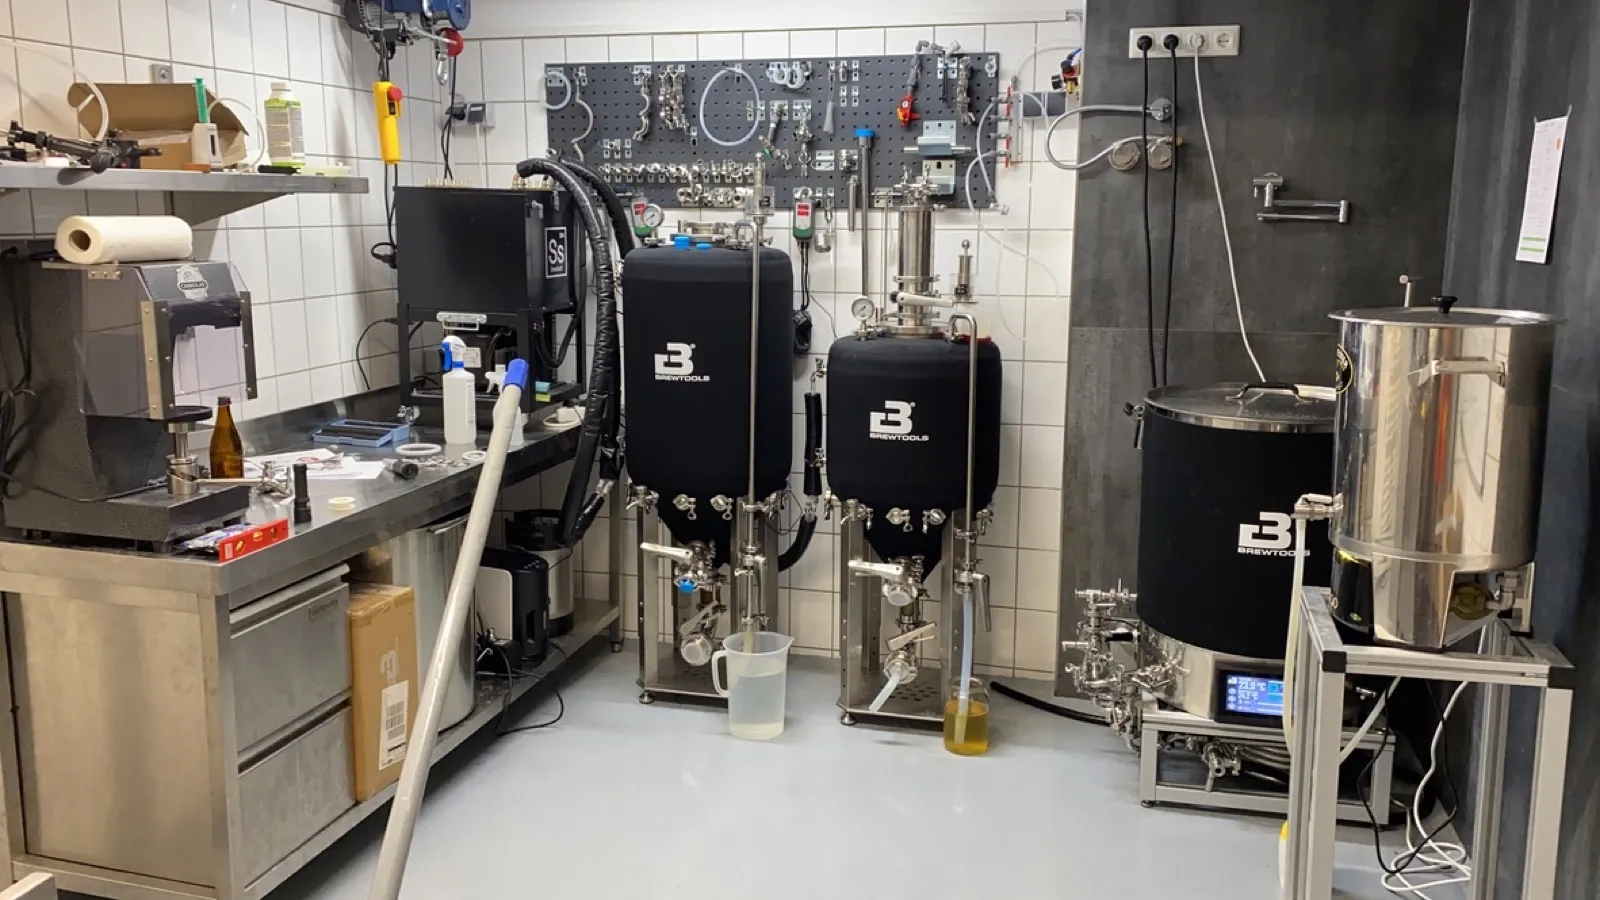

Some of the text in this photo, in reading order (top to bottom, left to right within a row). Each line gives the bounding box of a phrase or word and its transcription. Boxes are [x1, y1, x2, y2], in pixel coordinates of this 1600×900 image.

[548, 238, 564, 265] Ss
[870, 433, 929, 441] BREWTOOLS
[1238, 547, 1311, 556] BREWTOOS
